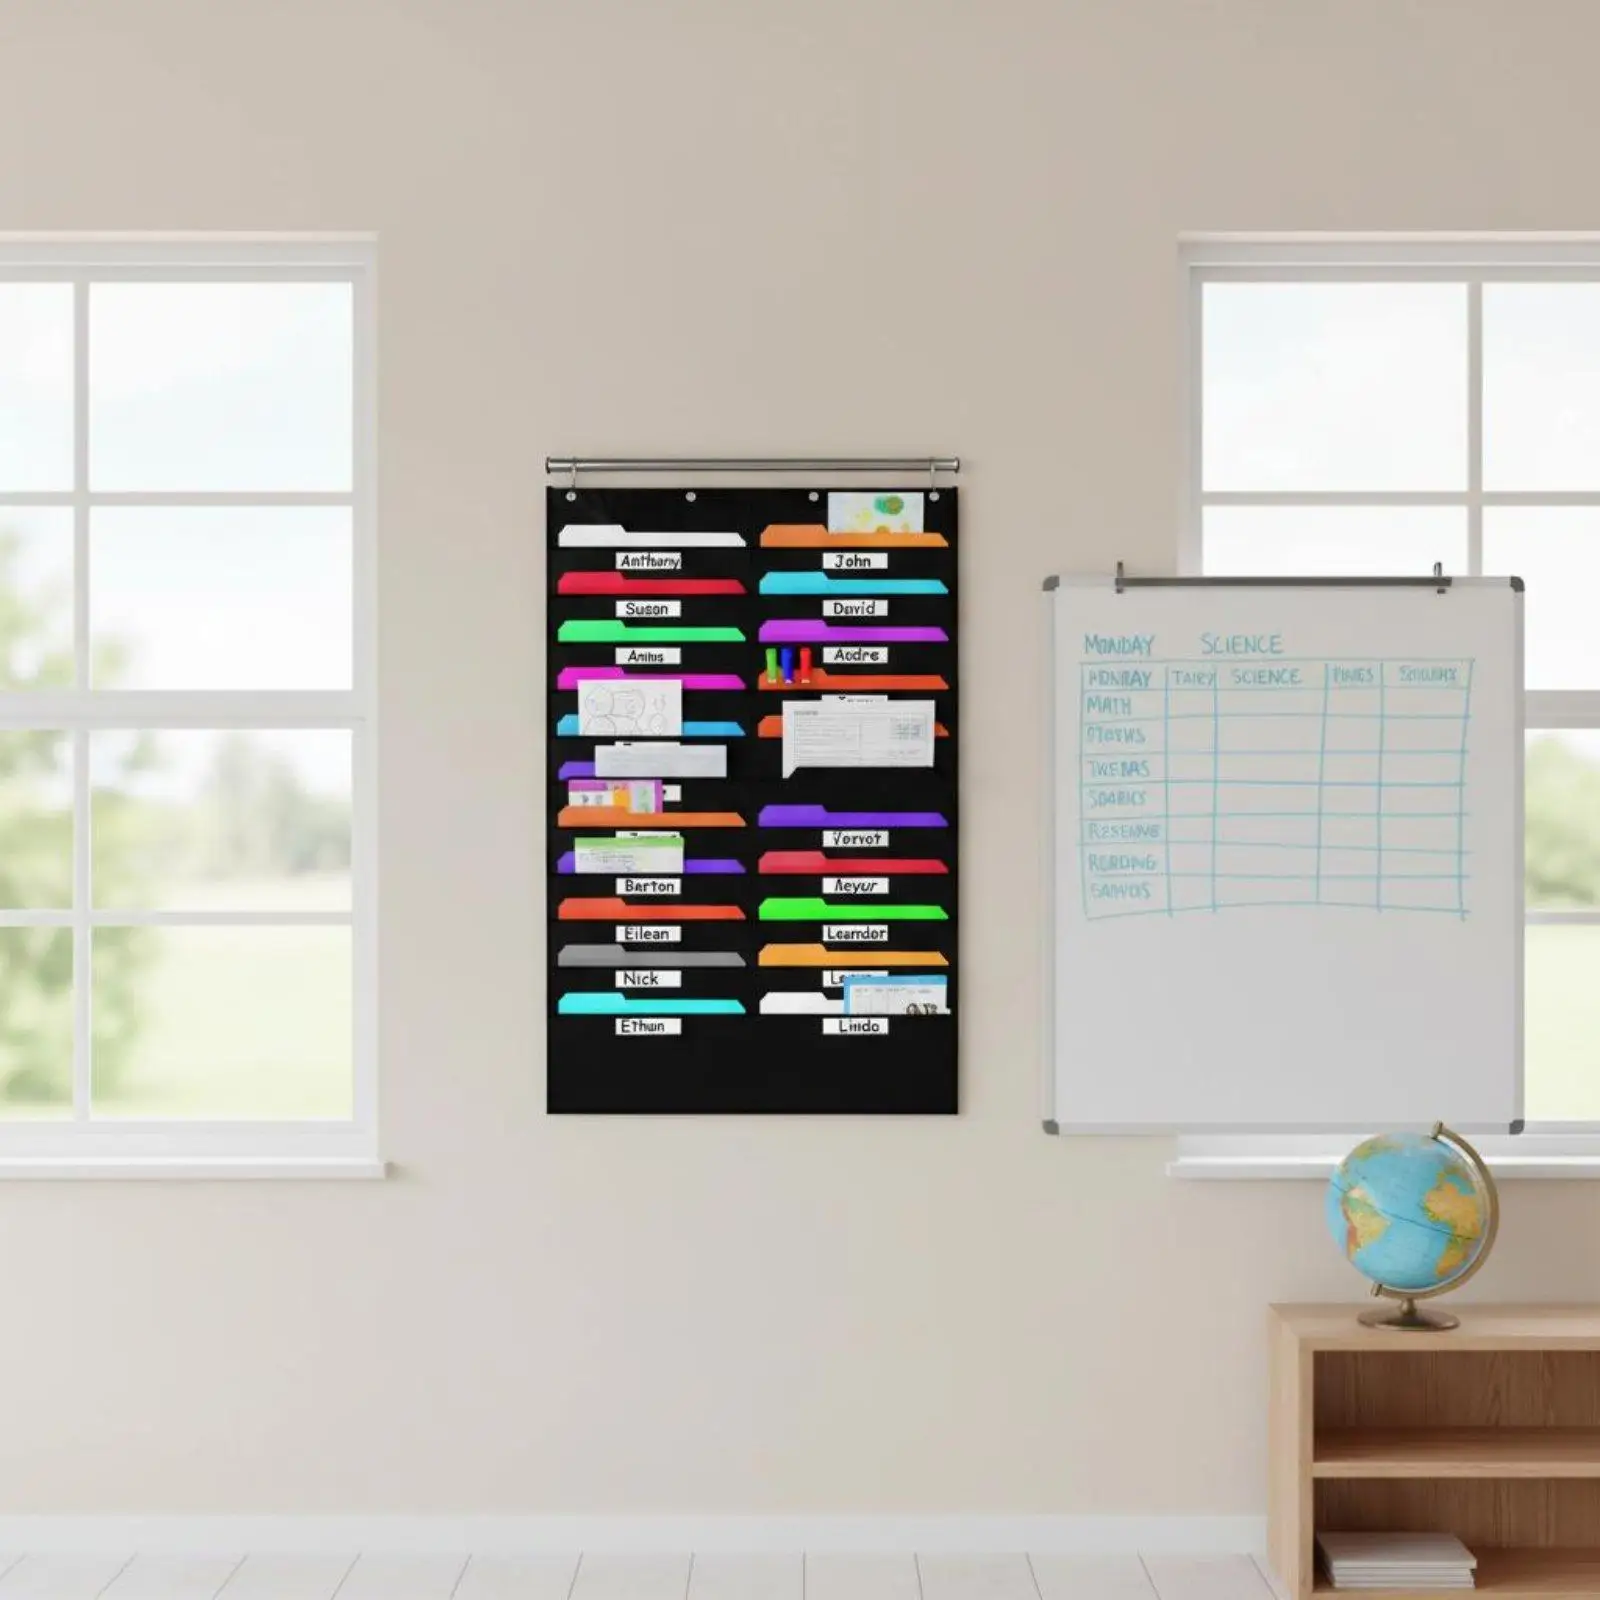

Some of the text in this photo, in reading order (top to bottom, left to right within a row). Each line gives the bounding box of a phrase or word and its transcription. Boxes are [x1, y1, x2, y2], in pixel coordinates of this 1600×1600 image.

[835, 555, 871, 568] John
[833, 602, 876, 615] David
[1084, 633, 1284, 656] MONDAY SCIENCE
[1231, 667, 1302, 686] SCIENCE
[1086, 696, 1132, 715] MATH
[623, 971, 659, 985] Nick
